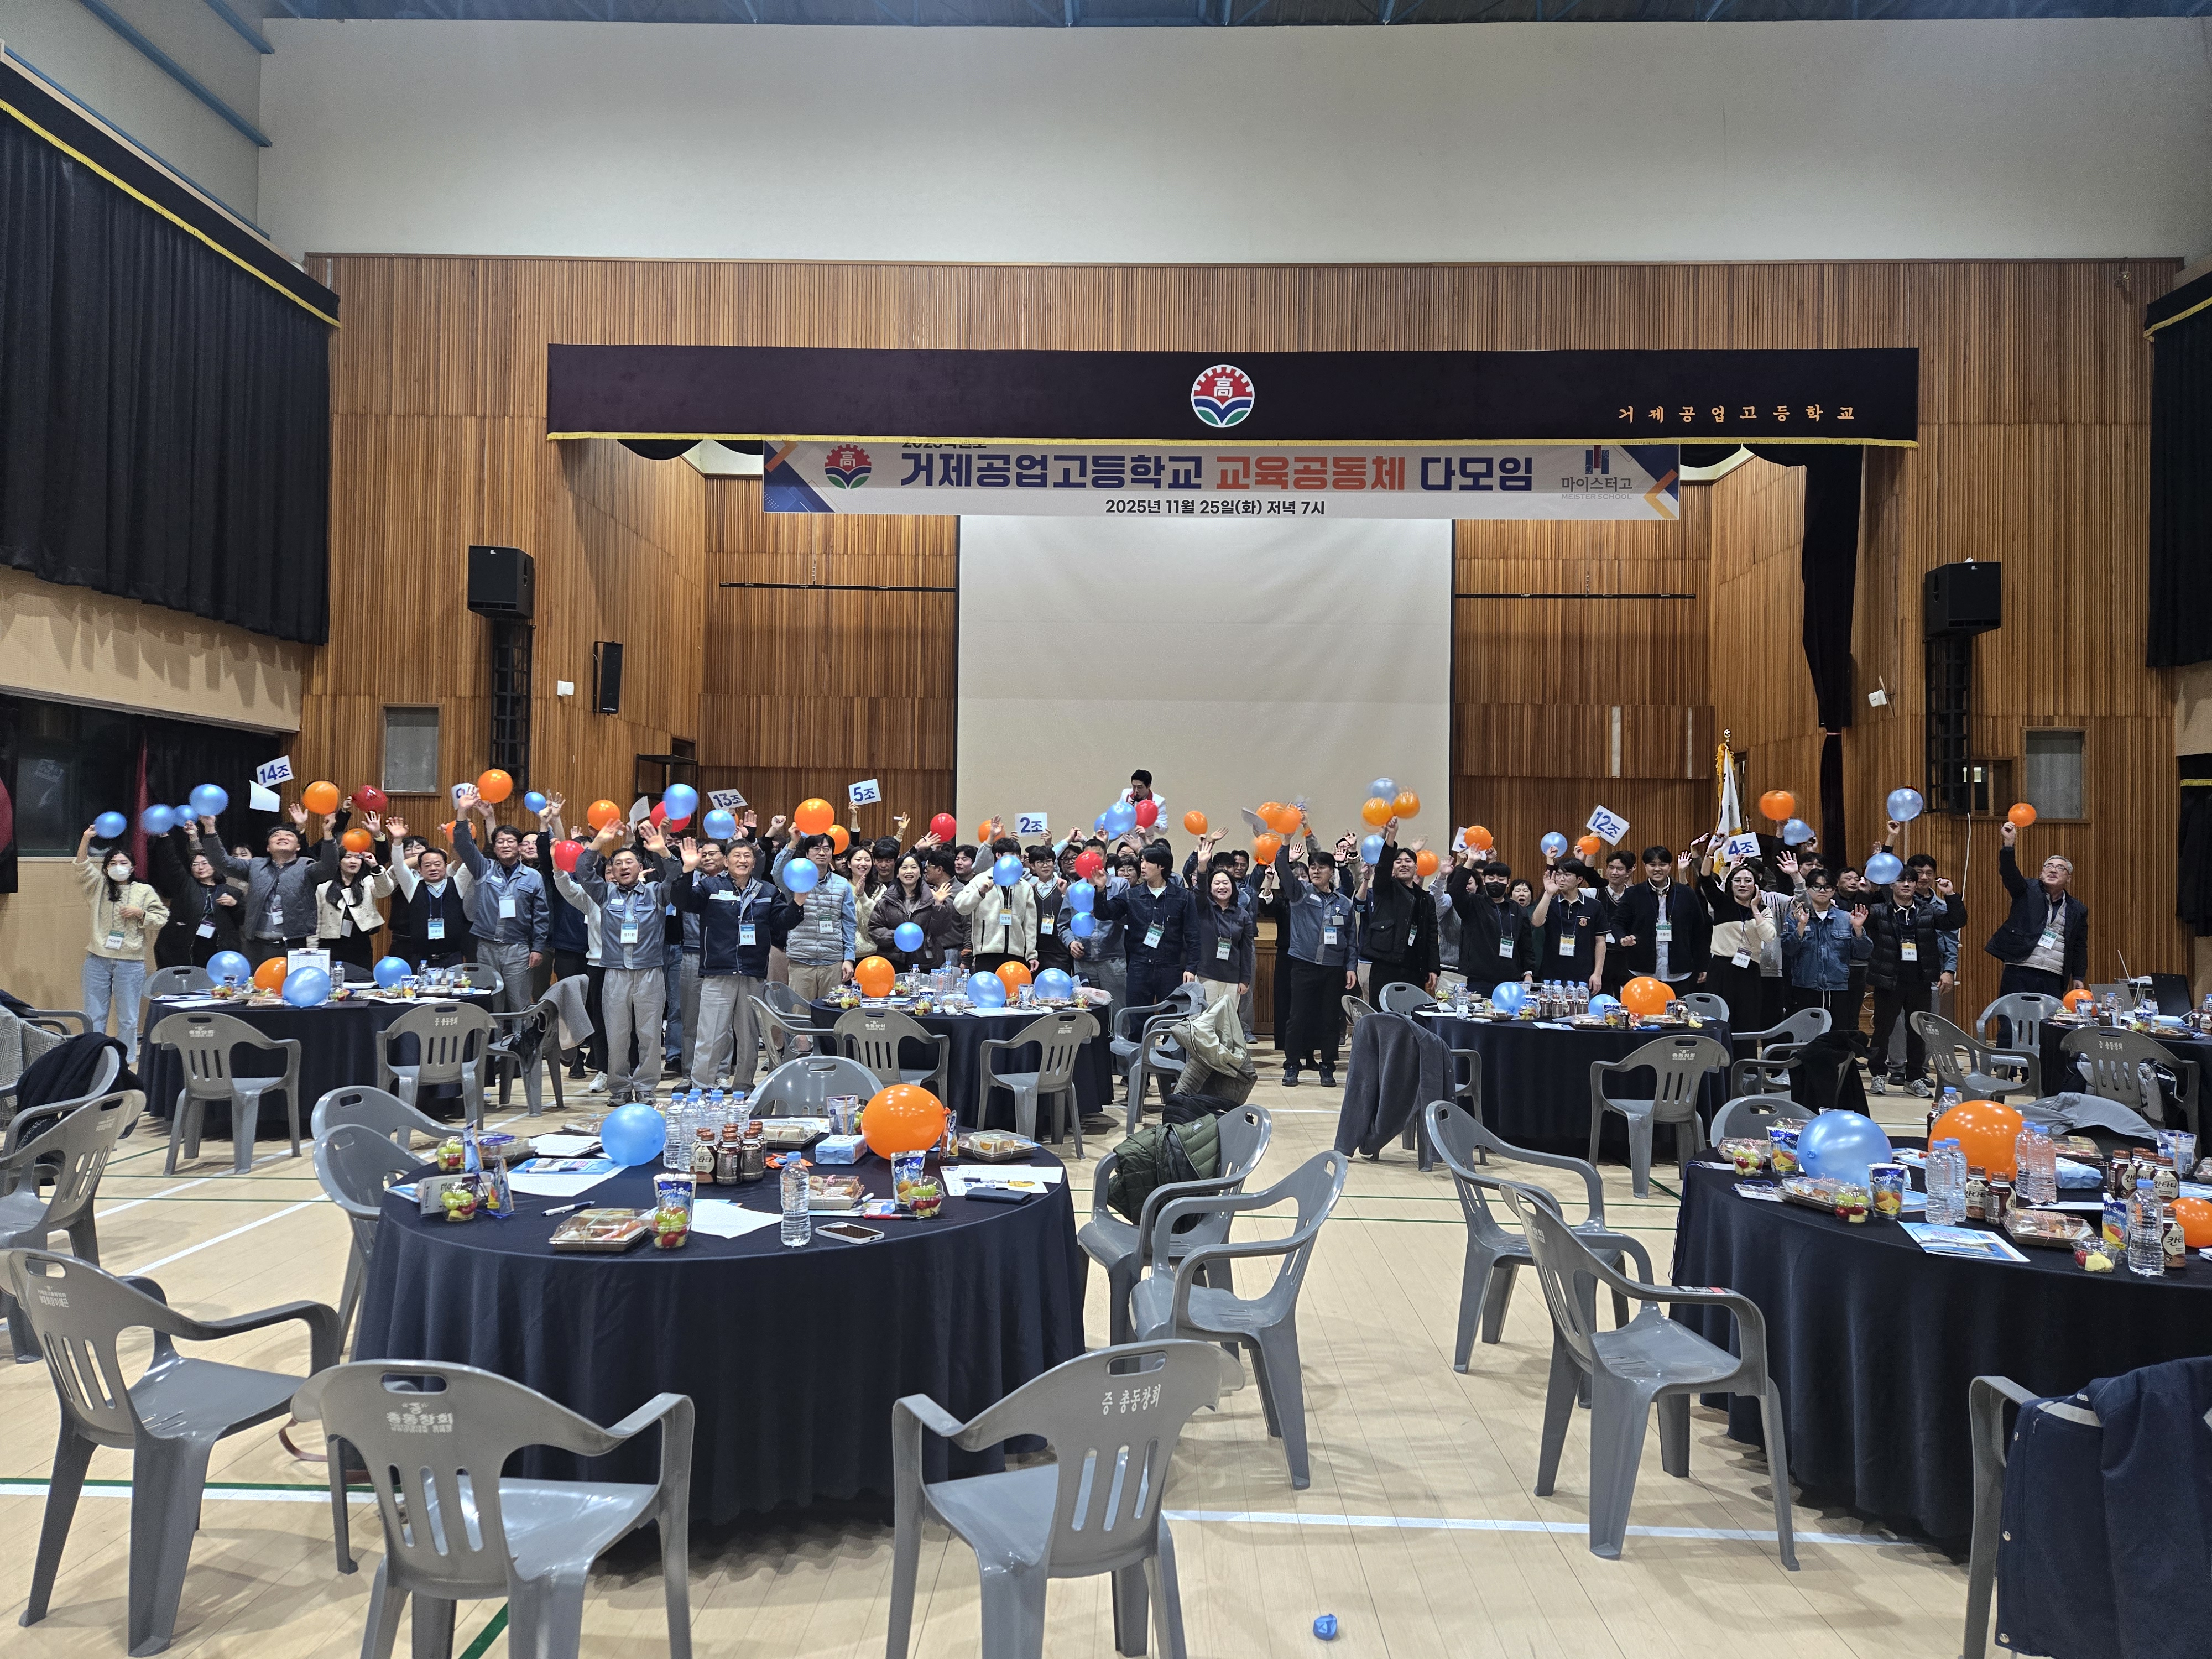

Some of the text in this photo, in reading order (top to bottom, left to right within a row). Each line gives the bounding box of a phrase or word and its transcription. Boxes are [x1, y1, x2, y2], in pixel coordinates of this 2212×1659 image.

[1214, 375, 1234, 398] 高
[1619, 404, 1855, 424] 거제공업고등학교
[839, 451, 856, 468] 高
[900, 452, 1533, 492] 거제공업고등학교 교육공동체 다모임
[1561, 476, 1633, 492] 마이스터고
[1105, 499, 1324, 515] 2025년 11월 25일(화) 저녁 7시
[260, 765, 290, 784] 14조
[713, 793, 743, 808] 13조
[854, 786, 875, 802] 5조
[1020, 817, 1043, 833] 2조
[1592, 811, 1620, 839] 12조
[1728, 839, 1755, 855] 4조
[1770, 1135, 1797, 1146] Capri-Sun
[658, 1186, 691, 1197] Capri-Sun
[2153, 1179, 2178, 1190] 칸타타
[1102, 1384, 1161, 1416] 증 총동창회
